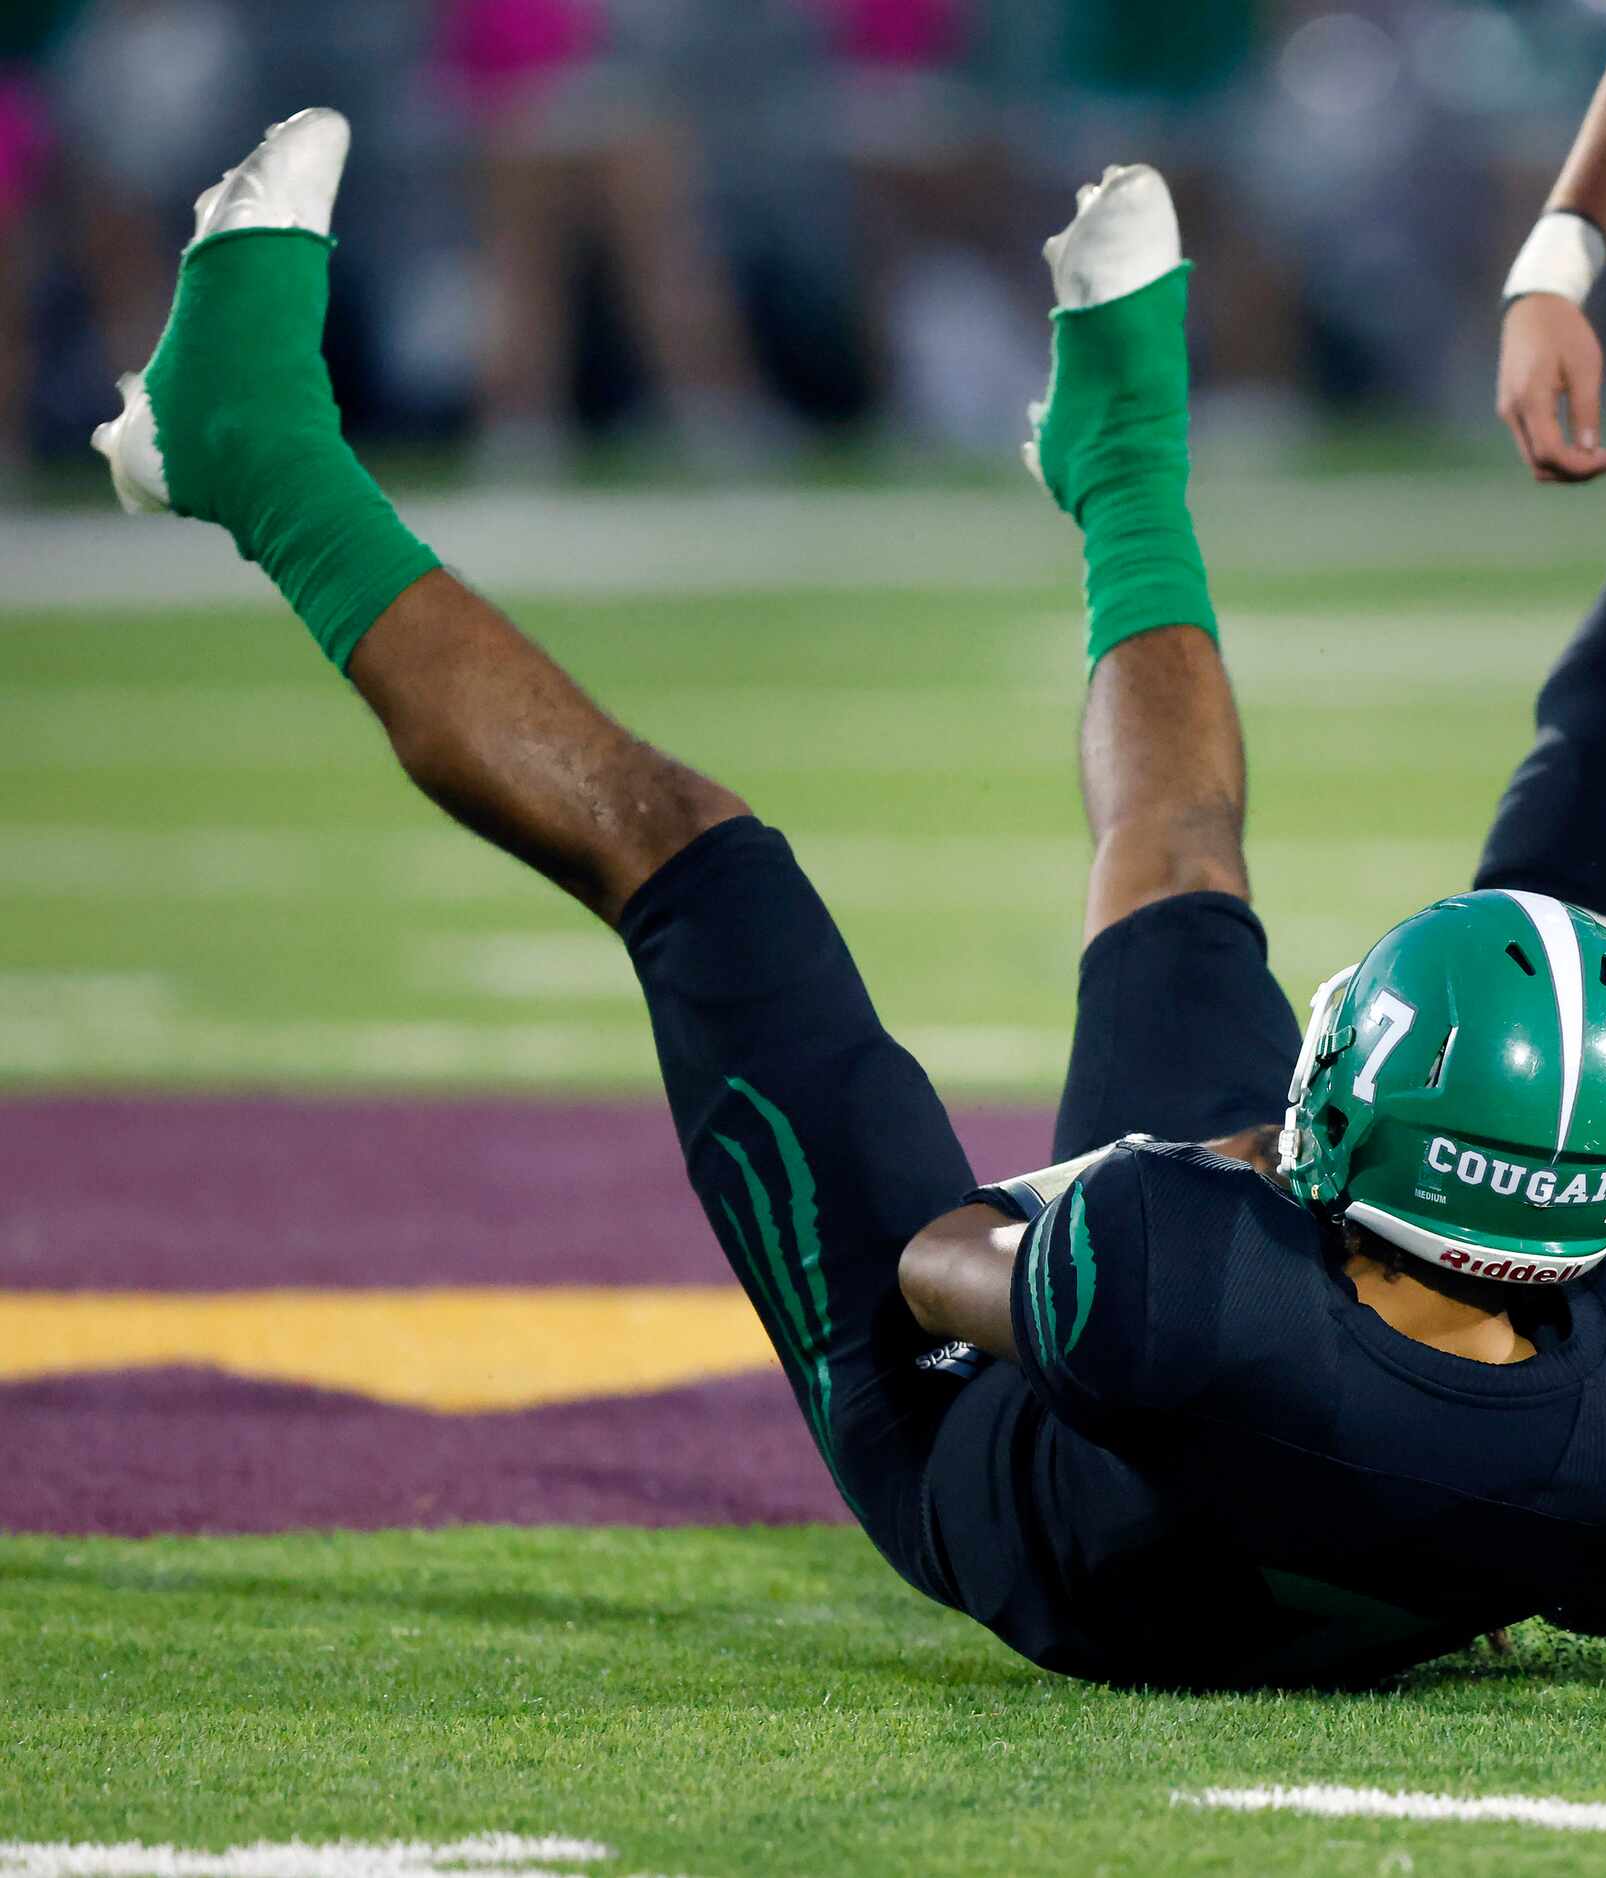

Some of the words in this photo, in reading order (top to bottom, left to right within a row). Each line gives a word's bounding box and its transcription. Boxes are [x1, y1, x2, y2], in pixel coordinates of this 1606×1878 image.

[1352, 987, 1418, 1105] 7
[1414, 1188, 1447, 1204] MEDIUM
[1440, 1249, 1584, 1283] Riddell
